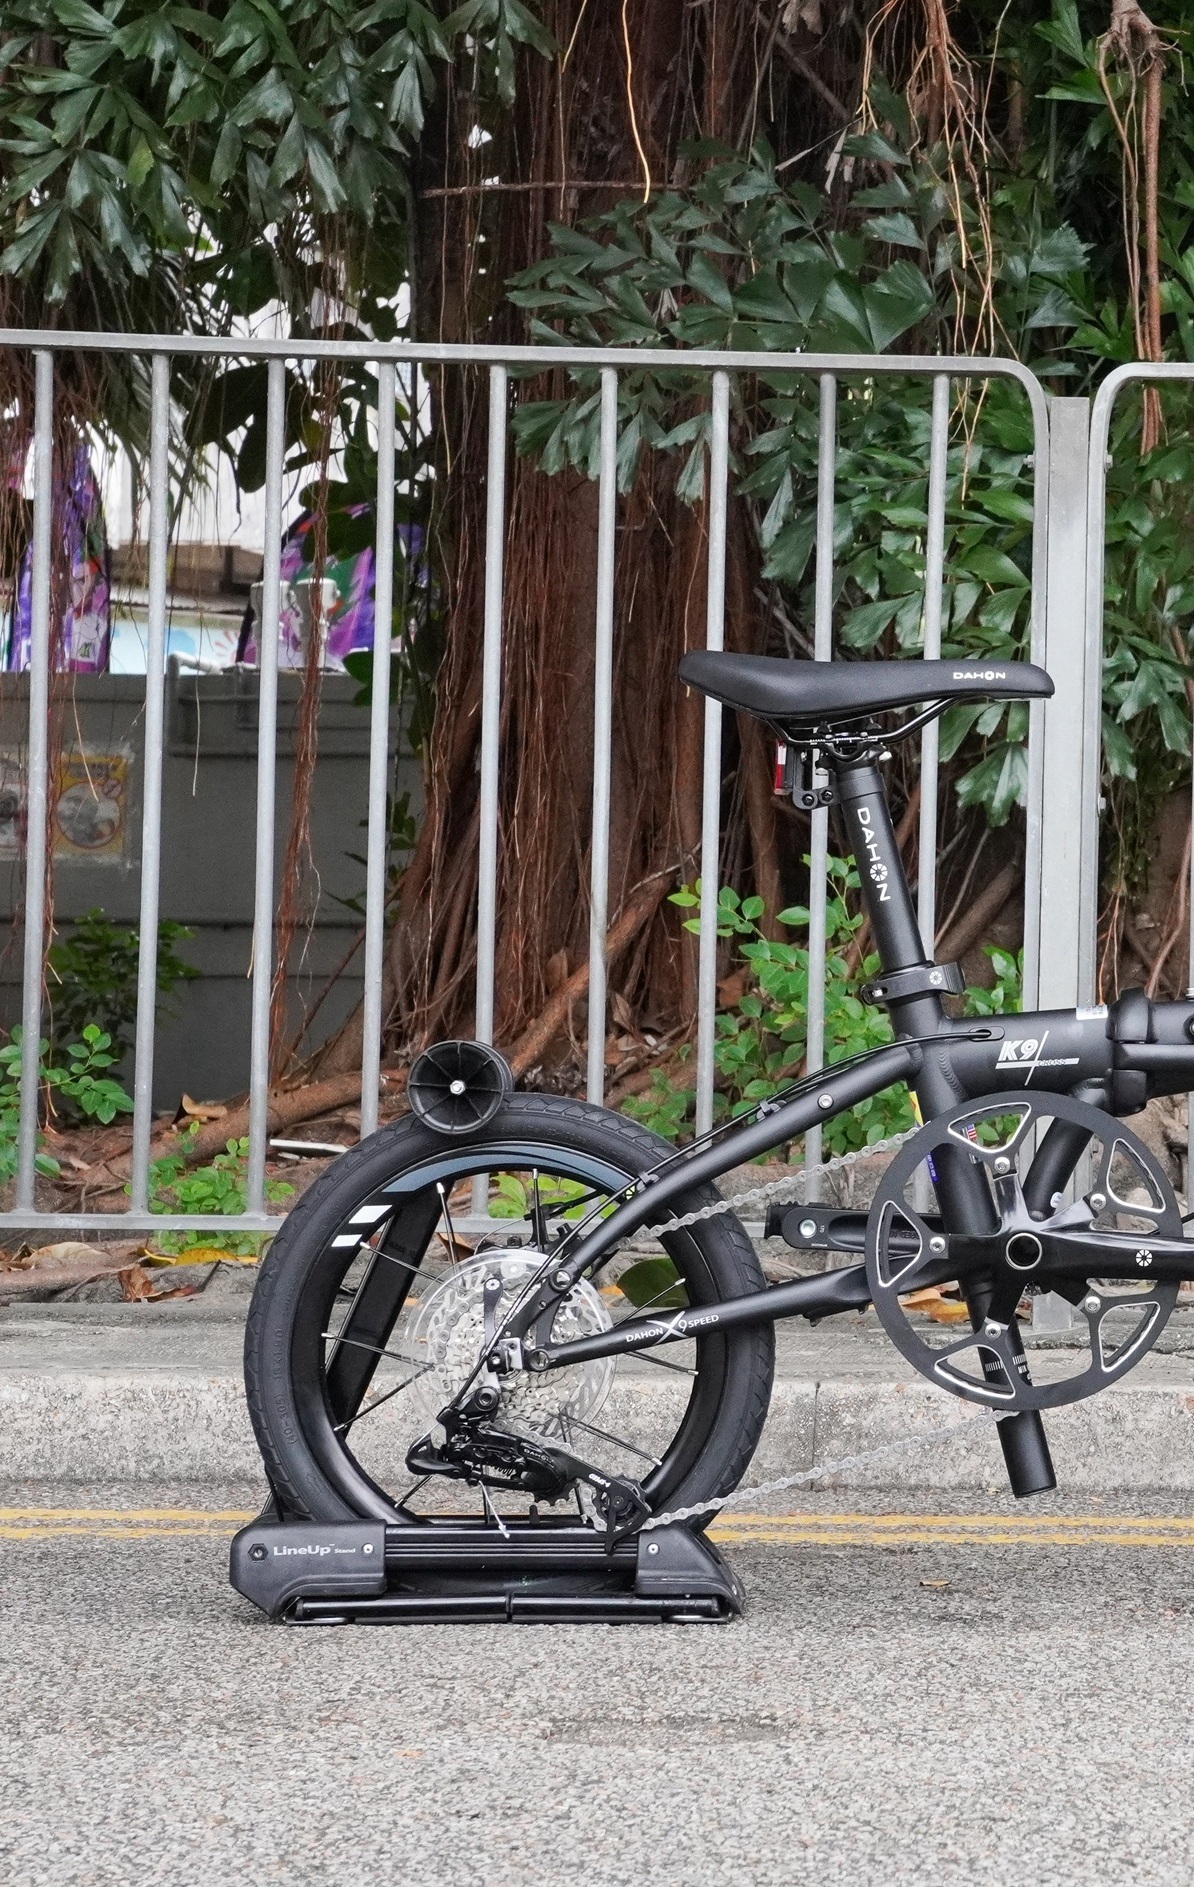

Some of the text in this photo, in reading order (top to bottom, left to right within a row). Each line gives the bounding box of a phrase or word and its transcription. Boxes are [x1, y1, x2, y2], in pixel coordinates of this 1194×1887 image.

[953, 671, 1006, 681] DAHON
[857, 807, 891, 902] DAHON
[998, 1038, 1039, 1062] K9
[625, 1327, 664, 1342] DAHON
[273, 1544, 331, 1557] LineUp
